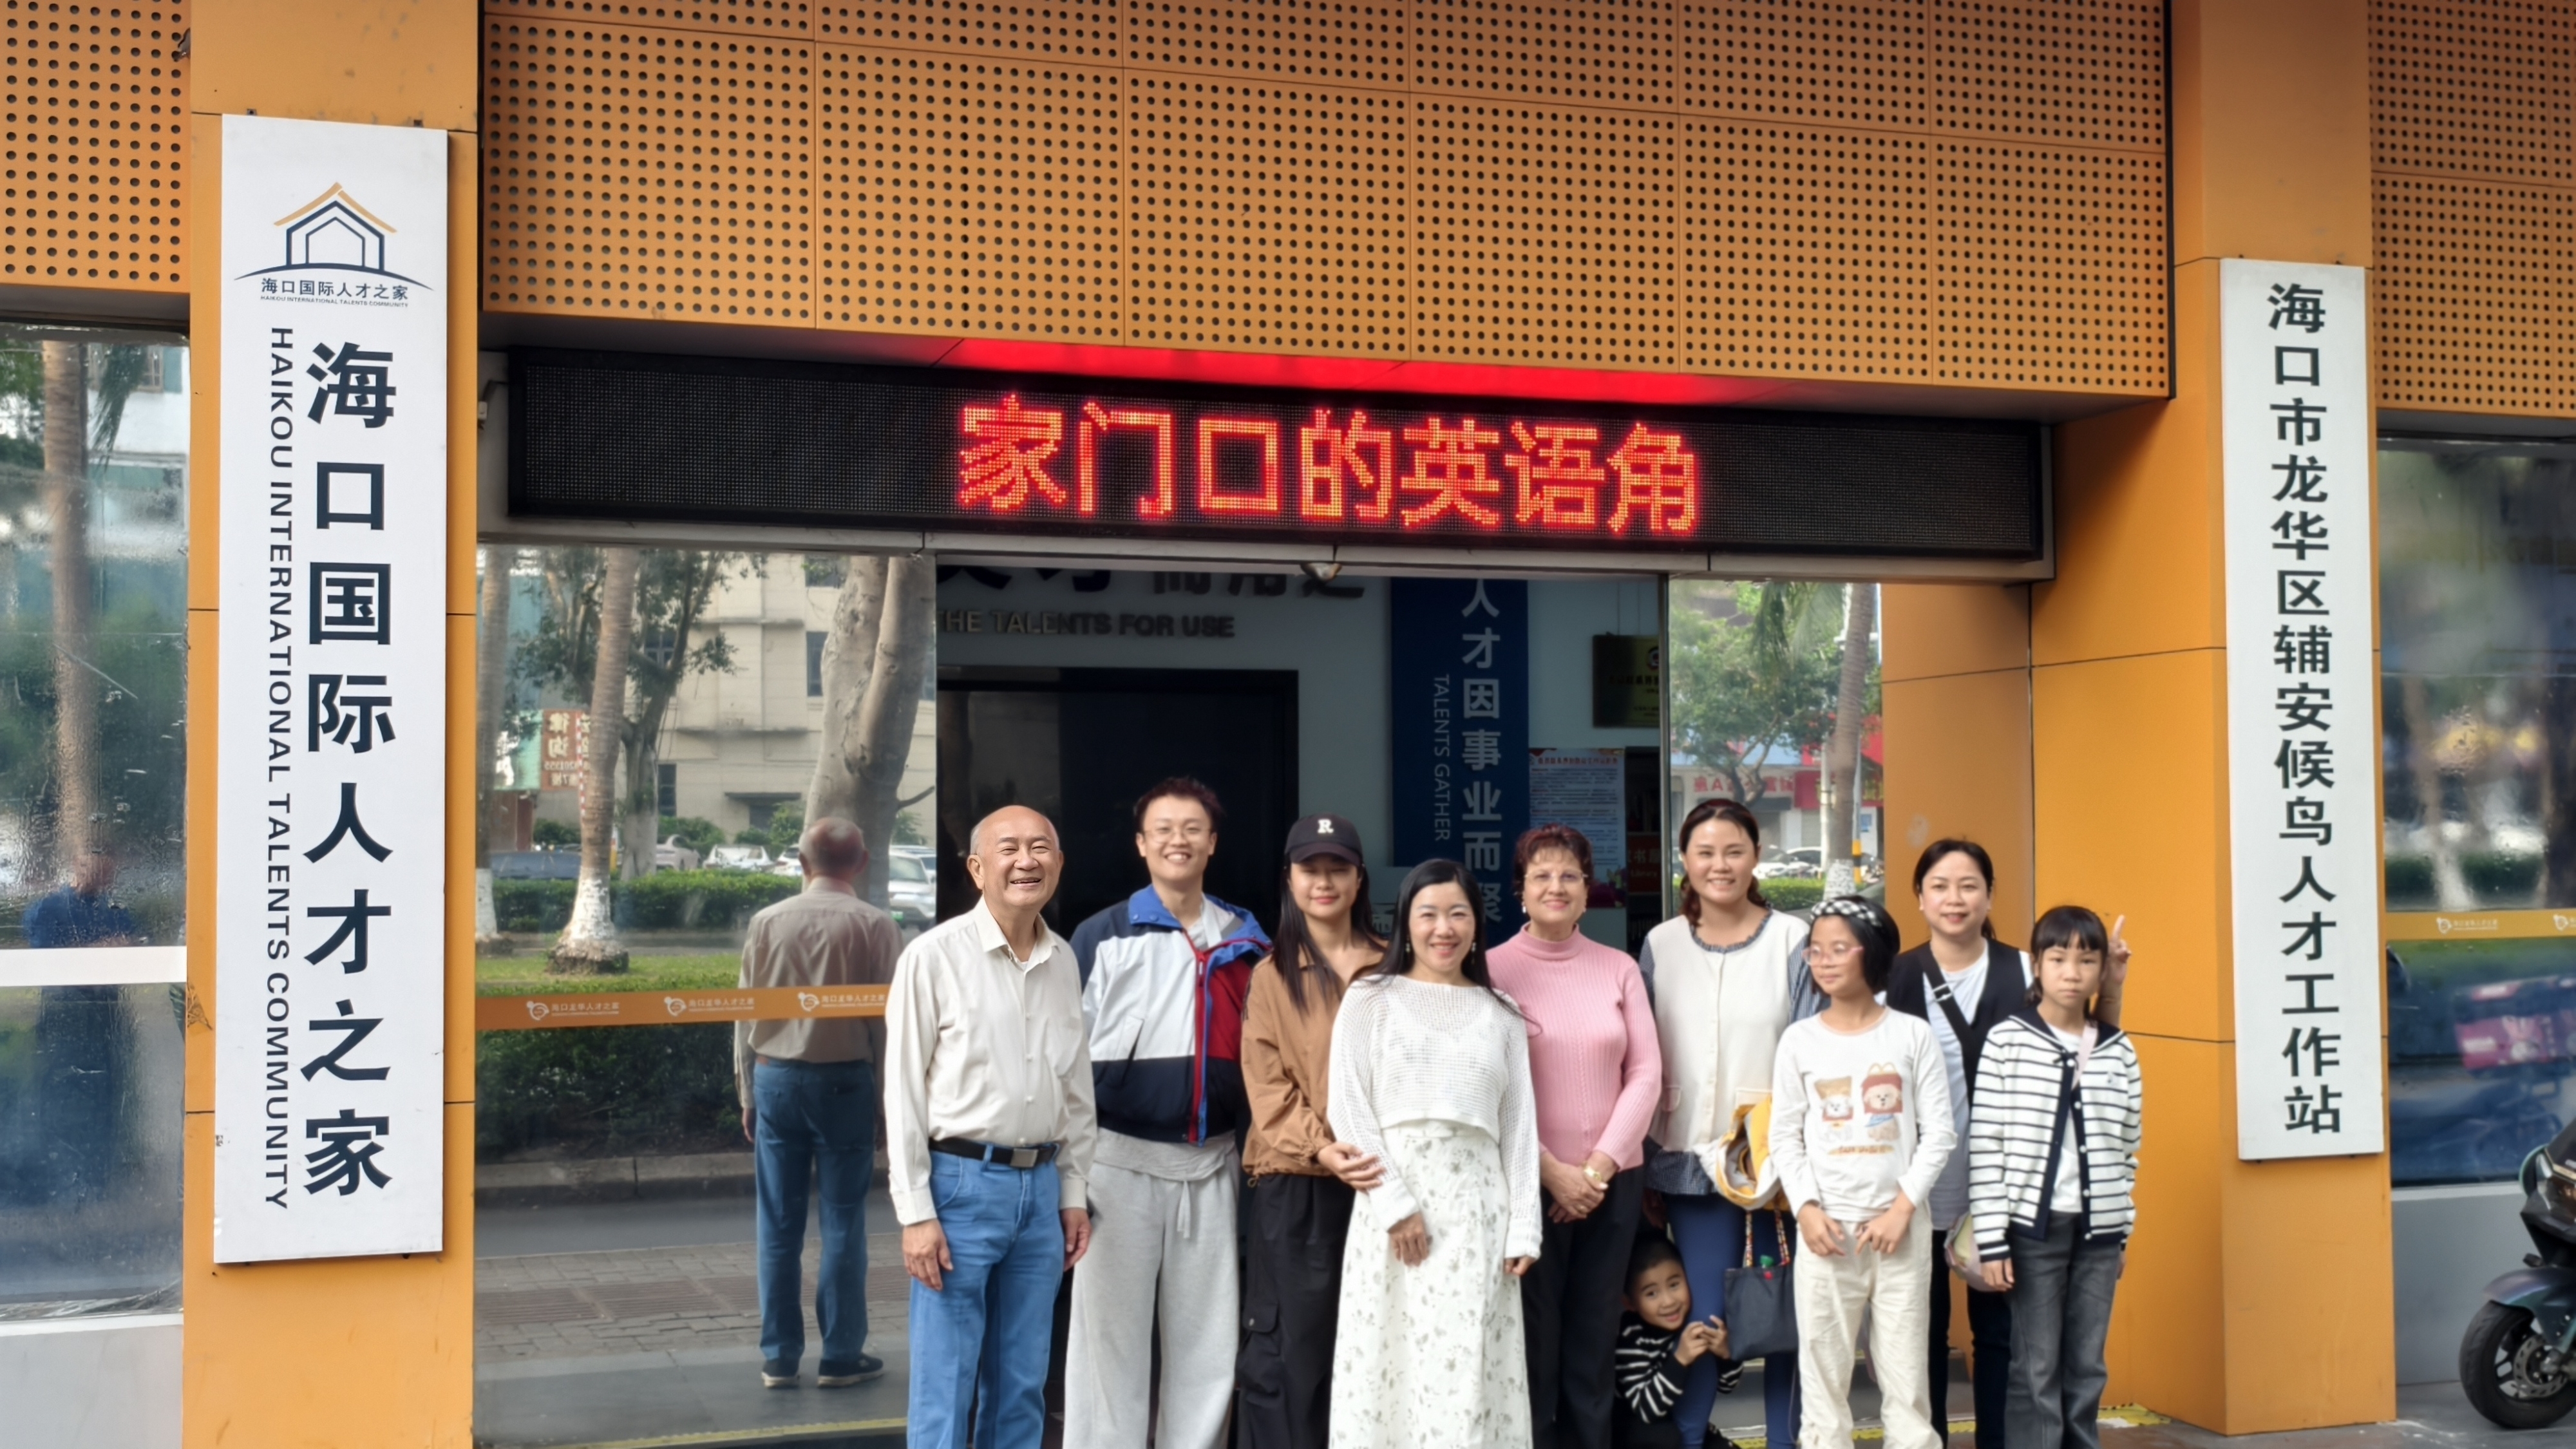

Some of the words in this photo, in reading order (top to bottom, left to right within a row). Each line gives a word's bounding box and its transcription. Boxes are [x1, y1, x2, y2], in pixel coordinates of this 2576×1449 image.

[261, 278, 408, 301] 海口国际人才之家
[287, 296, 338, 305] INTERNATIONAL
[270, 327, 294, 469] HAIKOU
[958, 394, 1696, 532] 家门口的英语角
[268, 481, 292, 783] INTERNATIONAL
[992, 611, 1112, 636] TALENTS
[1119, 613, 1173, 638] FOR
[1181, 616, 1236, 638] USE
[299, 341, 397, 1197] 海口国际人才之家
[1434, 674, 1450, 757] TALENTS
[2267, 283, 2342, 1134] 海口市龙华区辅安候鸟人才工作站
[1317, 819, 1334, 834] R
[1434, 763, 1450, 842] GATHER
[267, 793, 290, 961] TALENTS
[265, 971, 290, 1210] COMMUNITY
